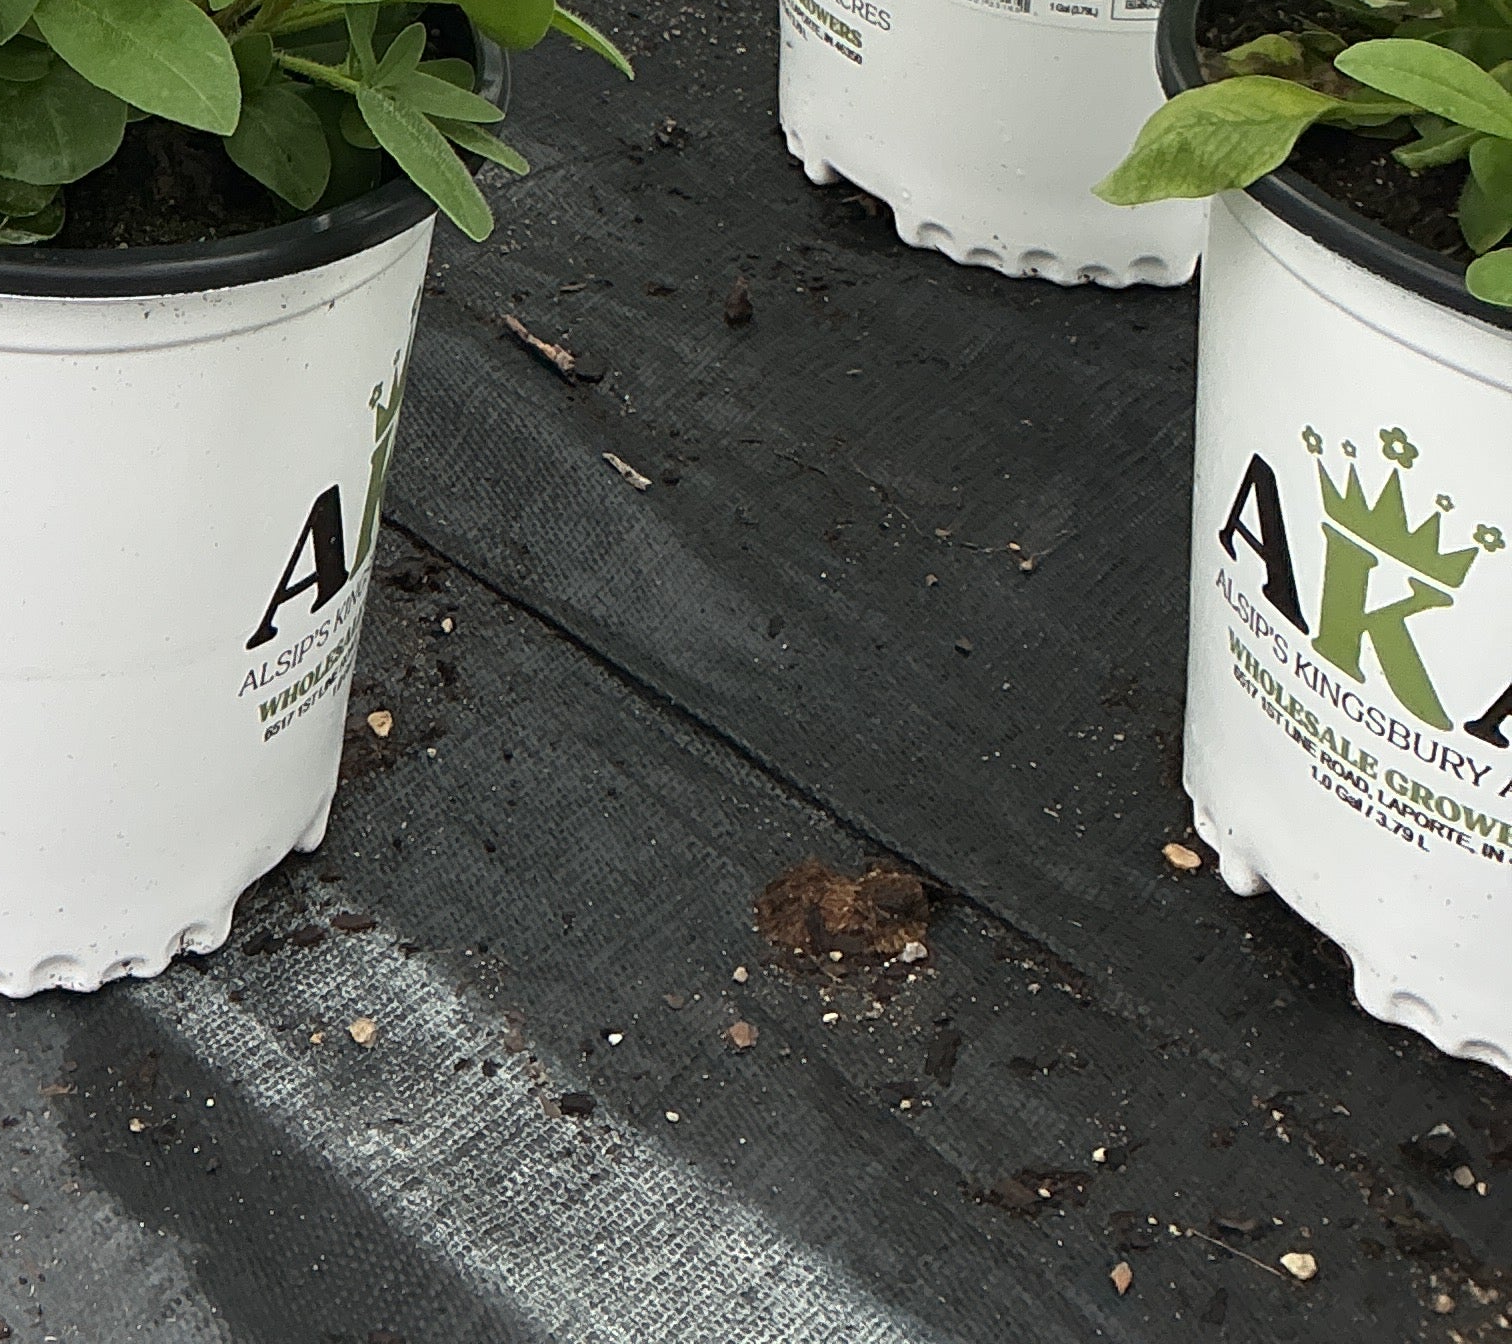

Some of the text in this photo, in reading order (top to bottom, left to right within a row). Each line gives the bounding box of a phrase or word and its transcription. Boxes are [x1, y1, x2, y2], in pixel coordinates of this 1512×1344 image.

[237, 618, 331, 698] ALSIP'S
[1216, 568, 1493, 788] ALSIP'S KINGSBURY
[1228, 624, 1512, 848] WHOLESALE GROWE
[1284, 719, 1319, 759] LINE
[1320, 750, 1374, 801] ROAD,
[1377, 788, 1476, 855] LAPORTE,
[1481, 843, 1505, 864] IN
[1311, 764, 1333, 792] 1.0
[1335, 784, 1364, 813] Gal
[1375, 810, 1415, 843] 3.79
[1418, 834, 1431, 853] L
